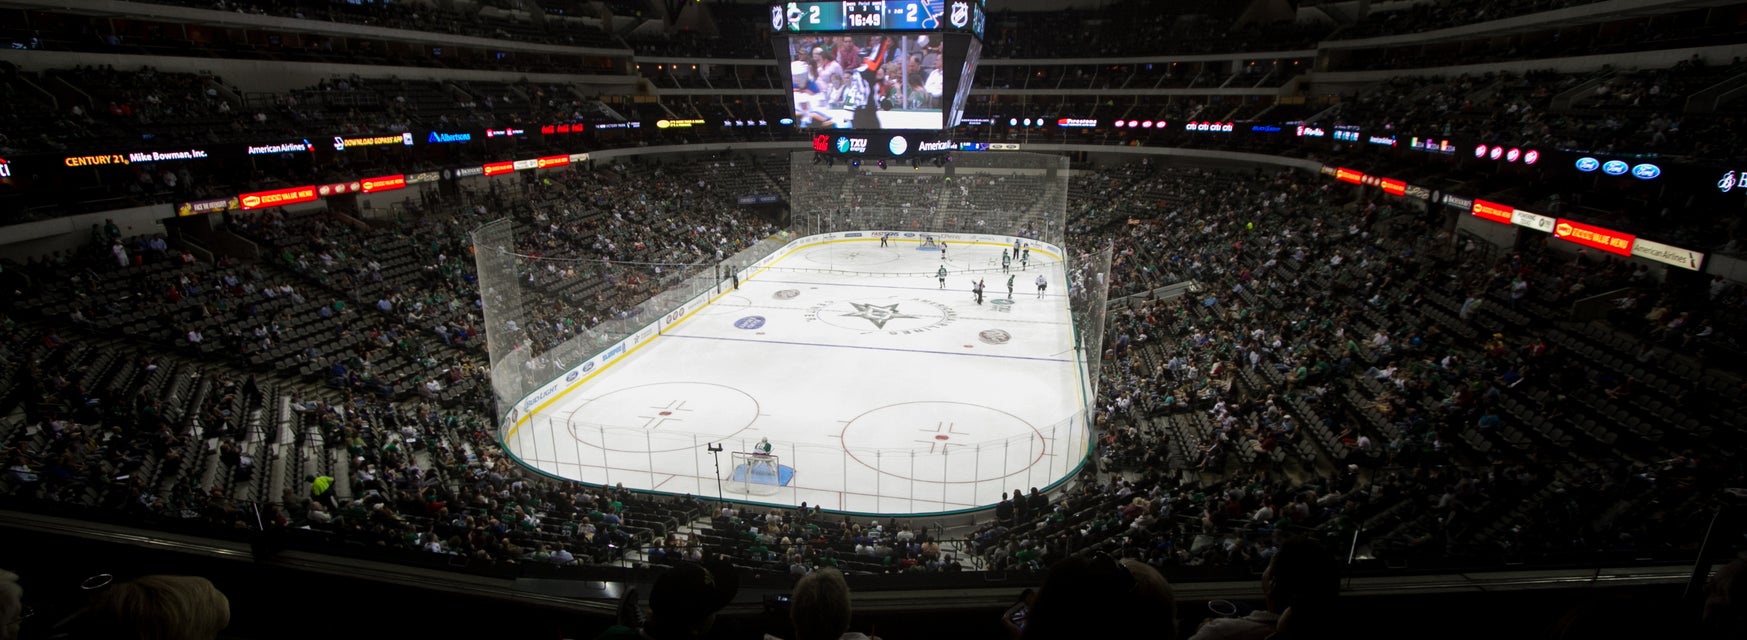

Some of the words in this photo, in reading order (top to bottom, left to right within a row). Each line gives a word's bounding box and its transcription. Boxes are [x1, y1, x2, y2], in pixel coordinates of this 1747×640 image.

[810, 5, 821, 24] 2
[906, 3, 918, 22] 2
[849, 14, 880, 26] 16:49
[344, 137, 374, 147] DOWNLOAD
[440, 133, 470, 142] Albertsons
[850, 139, 867, 148] TXU
[65, 155, 111, 167] CENTURY
[129, 152, 152, 162] Mike
[152, 150, 192, 161] Bowman,
[192, 149, 208, 158] Inc.
